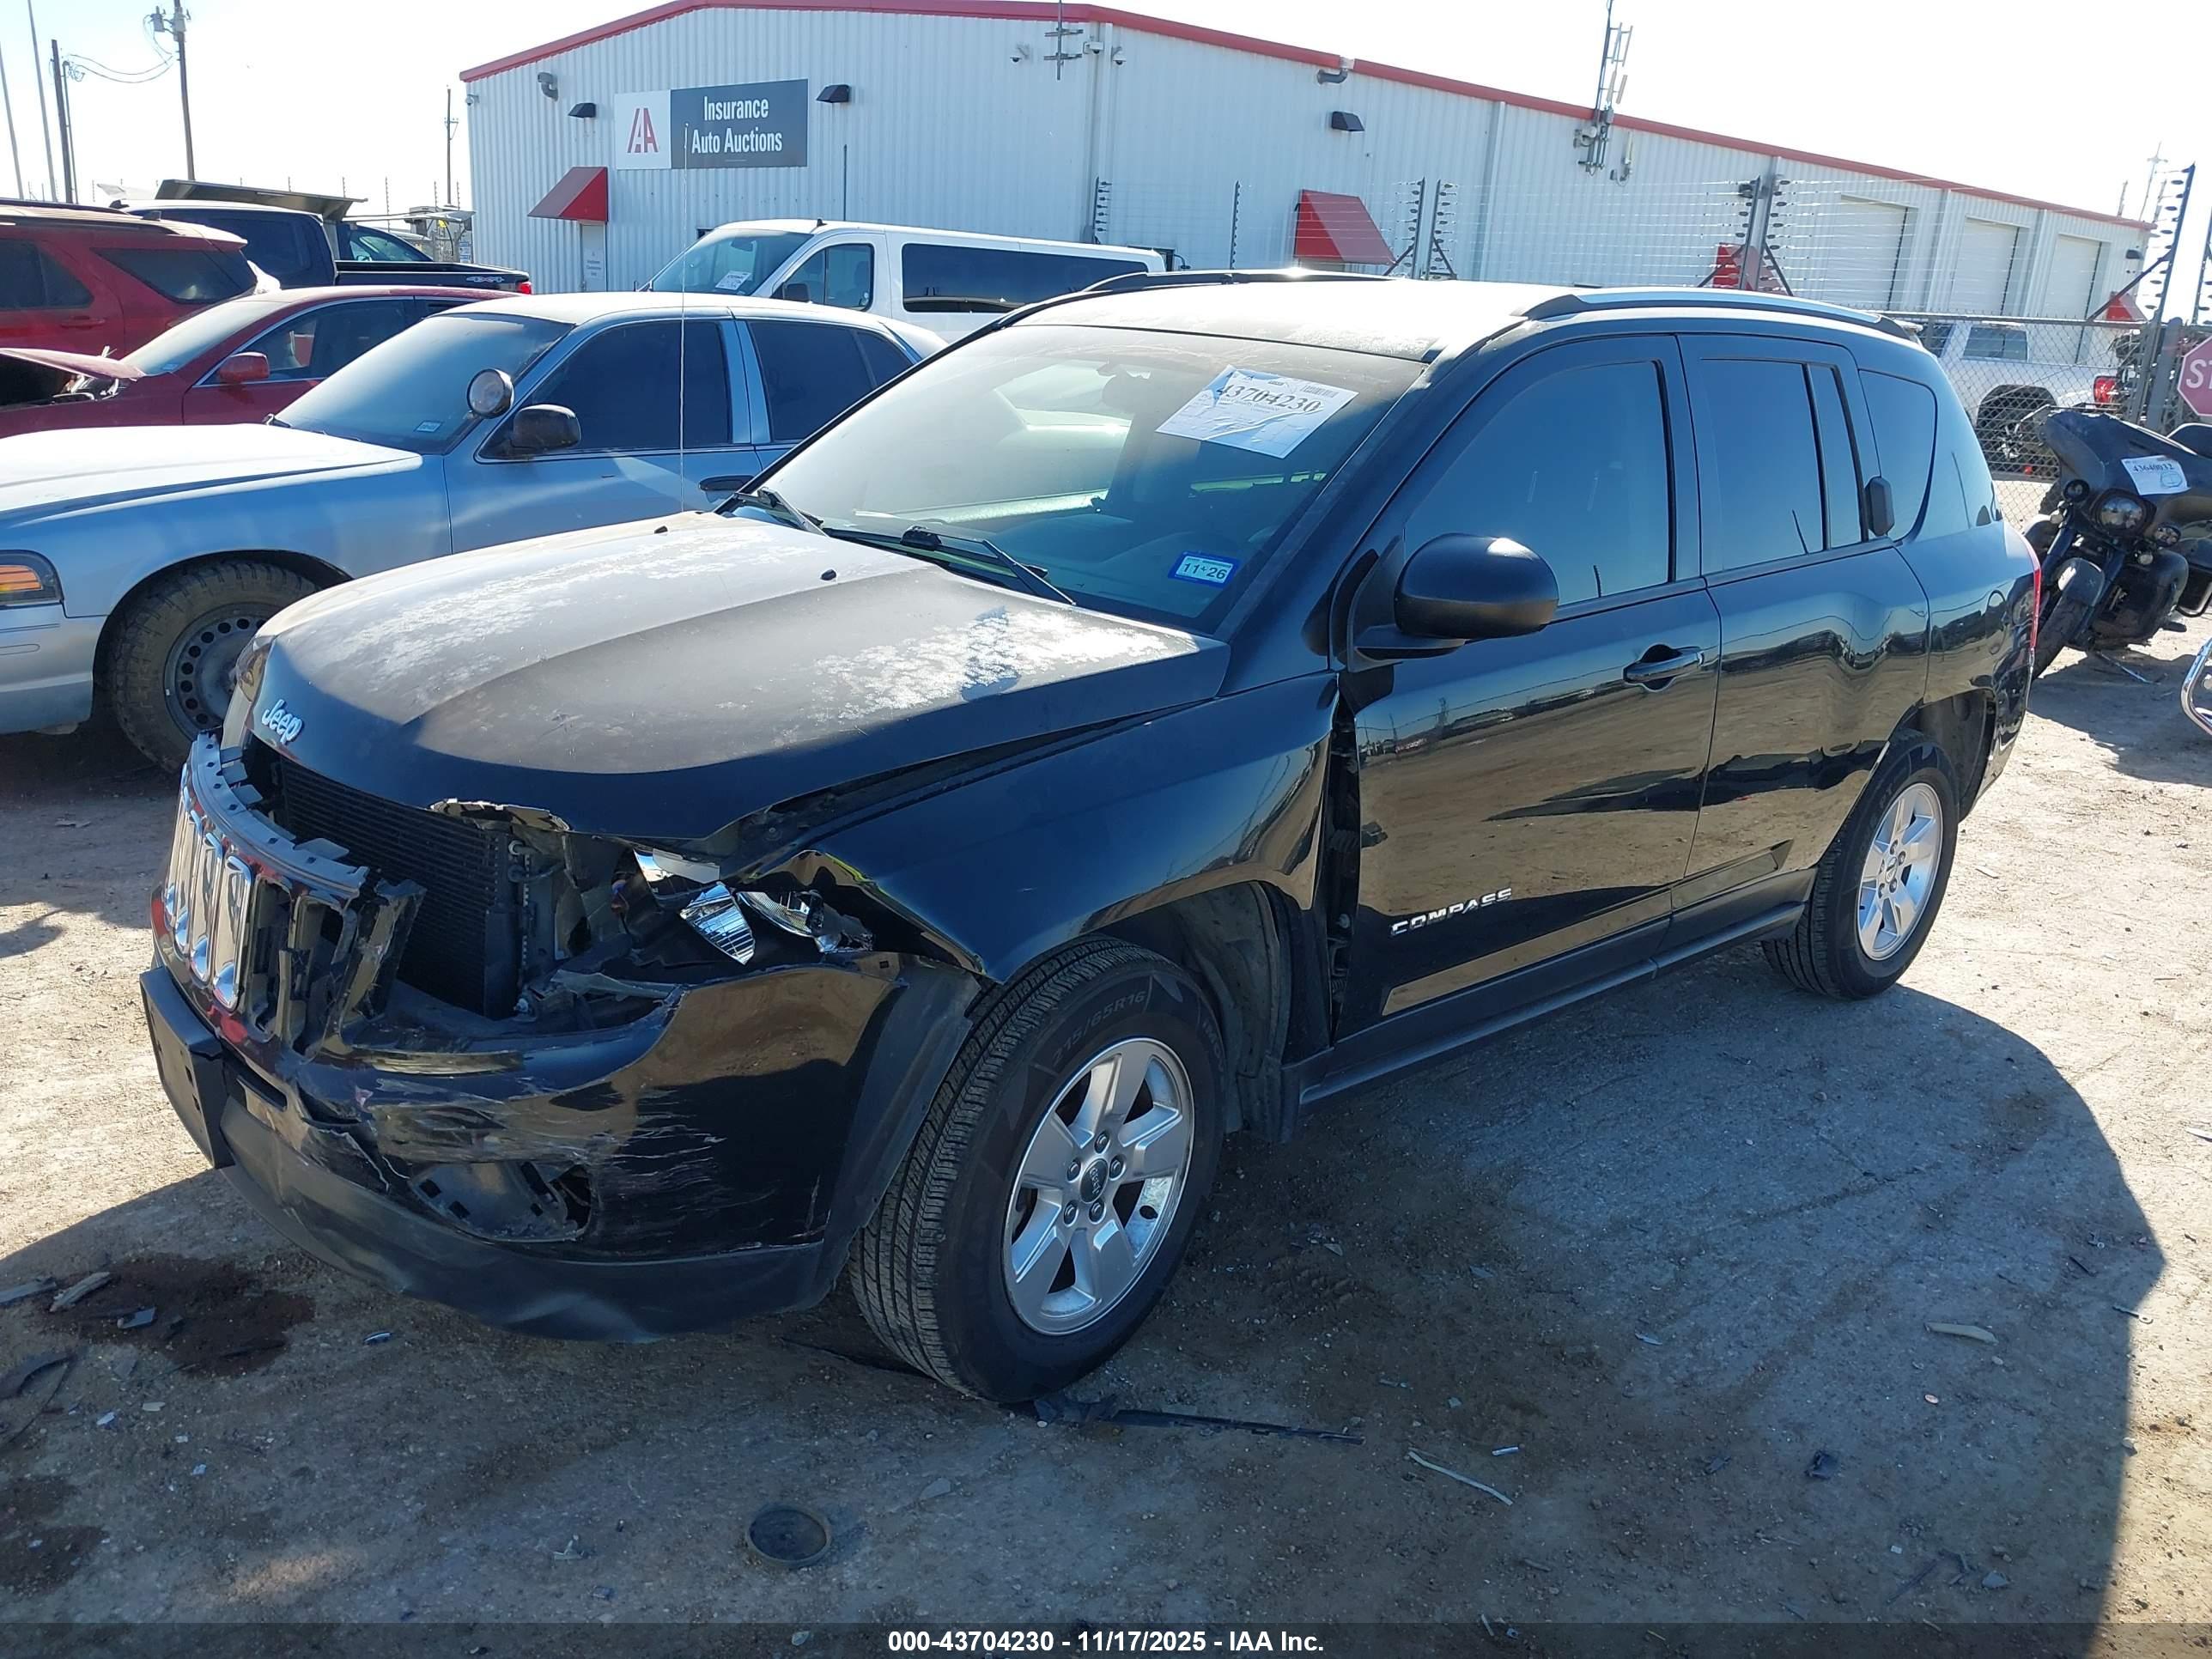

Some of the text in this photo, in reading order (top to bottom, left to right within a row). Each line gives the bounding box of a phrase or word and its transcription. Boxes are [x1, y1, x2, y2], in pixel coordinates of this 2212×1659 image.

[703, 95, 769, 121] Insurance
[691, 126, 783, 155] Auto Auctions
[1216, 384, 1322, 413] 43704230
[261, 698, 304, 745] Jeep
[1390, 887, 1512, 935] COMPASS
